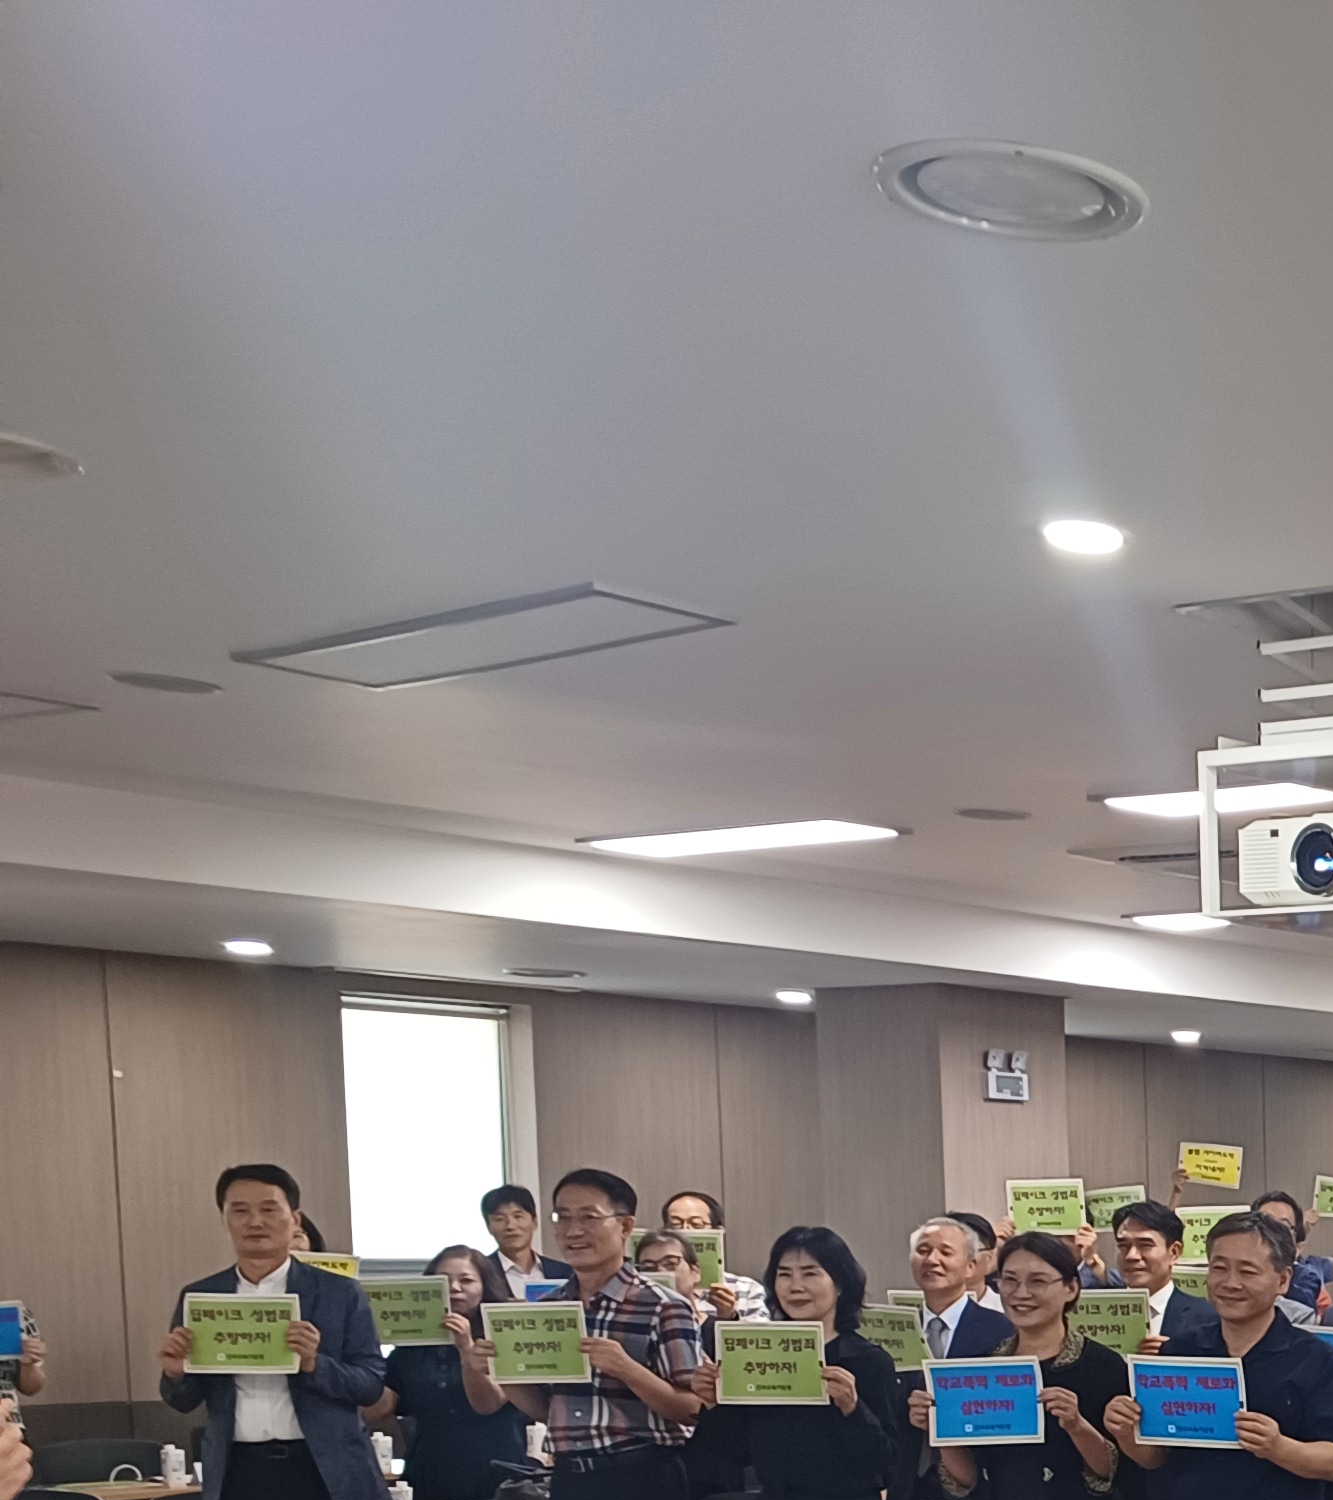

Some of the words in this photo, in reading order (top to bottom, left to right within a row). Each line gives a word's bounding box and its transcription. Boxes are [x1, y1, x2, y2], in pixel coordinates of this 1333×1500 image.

[366, 1290, 403, 1301] 페이크
[191, 1309, 243, 1323] 딥페이크
[250, 1308, 291, 1323] 성범죄
[1107, 1302, 1143, 1315] 성범죄
[491, 1318, 537, 1332] 딥페이크
[542, 1317, 578, 1332] 성범죄
[213, 1331, 271, 1345] 추방하자!
[724, 1337, 771, 1351] 딥페이크
[778, 1338, 816, 1352] 성범죄
[512, 1341, 562, 1354] 추방하자!
[743, 1361, 797, 1374] 추방하자!
[936, 1375, 988, 1390] 학교폭력
[995, 1374, 1034, 1388] 제로화
[1137, 1375, 1189, 1391] 학교폭력
[1196, 1377, 1237, 1391] 제로화
[960, 1400, 1015, 1416] 실현하자!
[1161, 1401, 1217, 1417] 실현하자!
